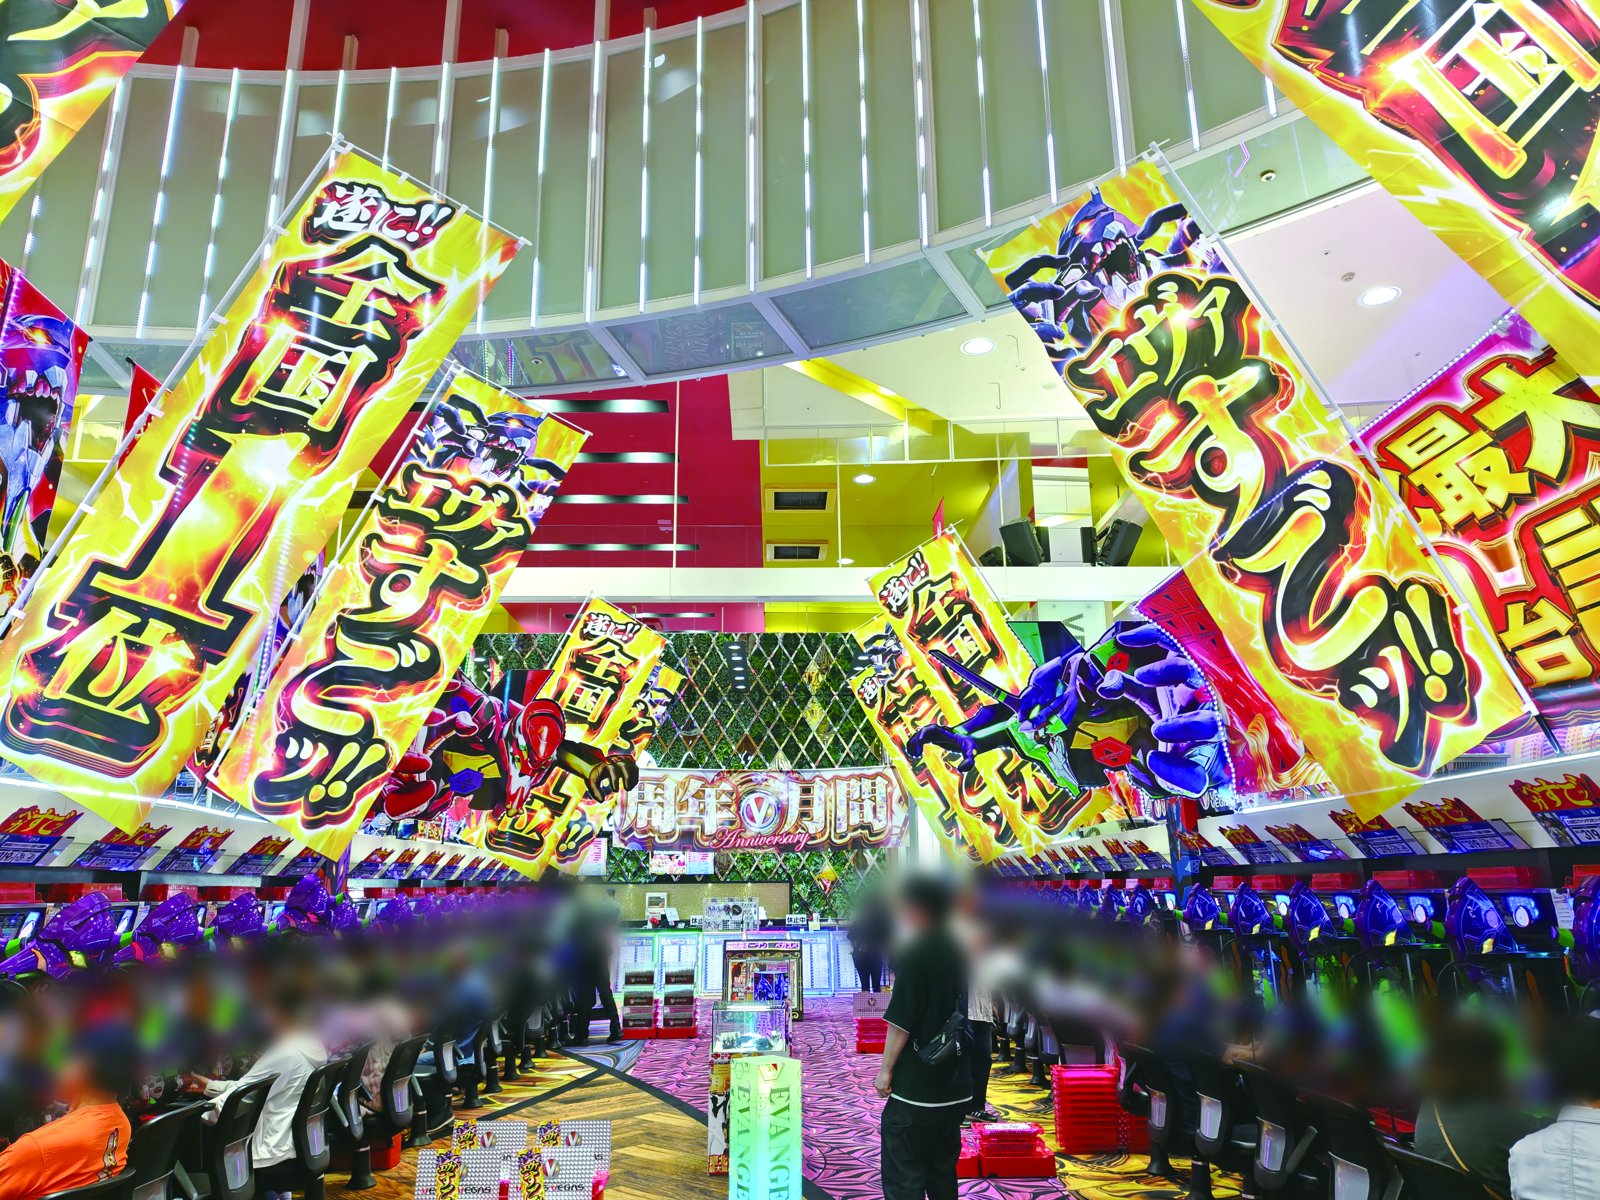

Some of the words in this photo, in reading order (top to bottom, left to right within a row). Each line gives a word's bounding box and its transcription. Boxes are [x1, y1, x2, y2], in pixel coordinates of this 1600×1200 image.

[312, 184, 453, 245] 遂に!!
[782, 776, 890, 835] 月間
[710, 827, 810, 851] Anniversary
[786, 916, 806, 924] 休止中
